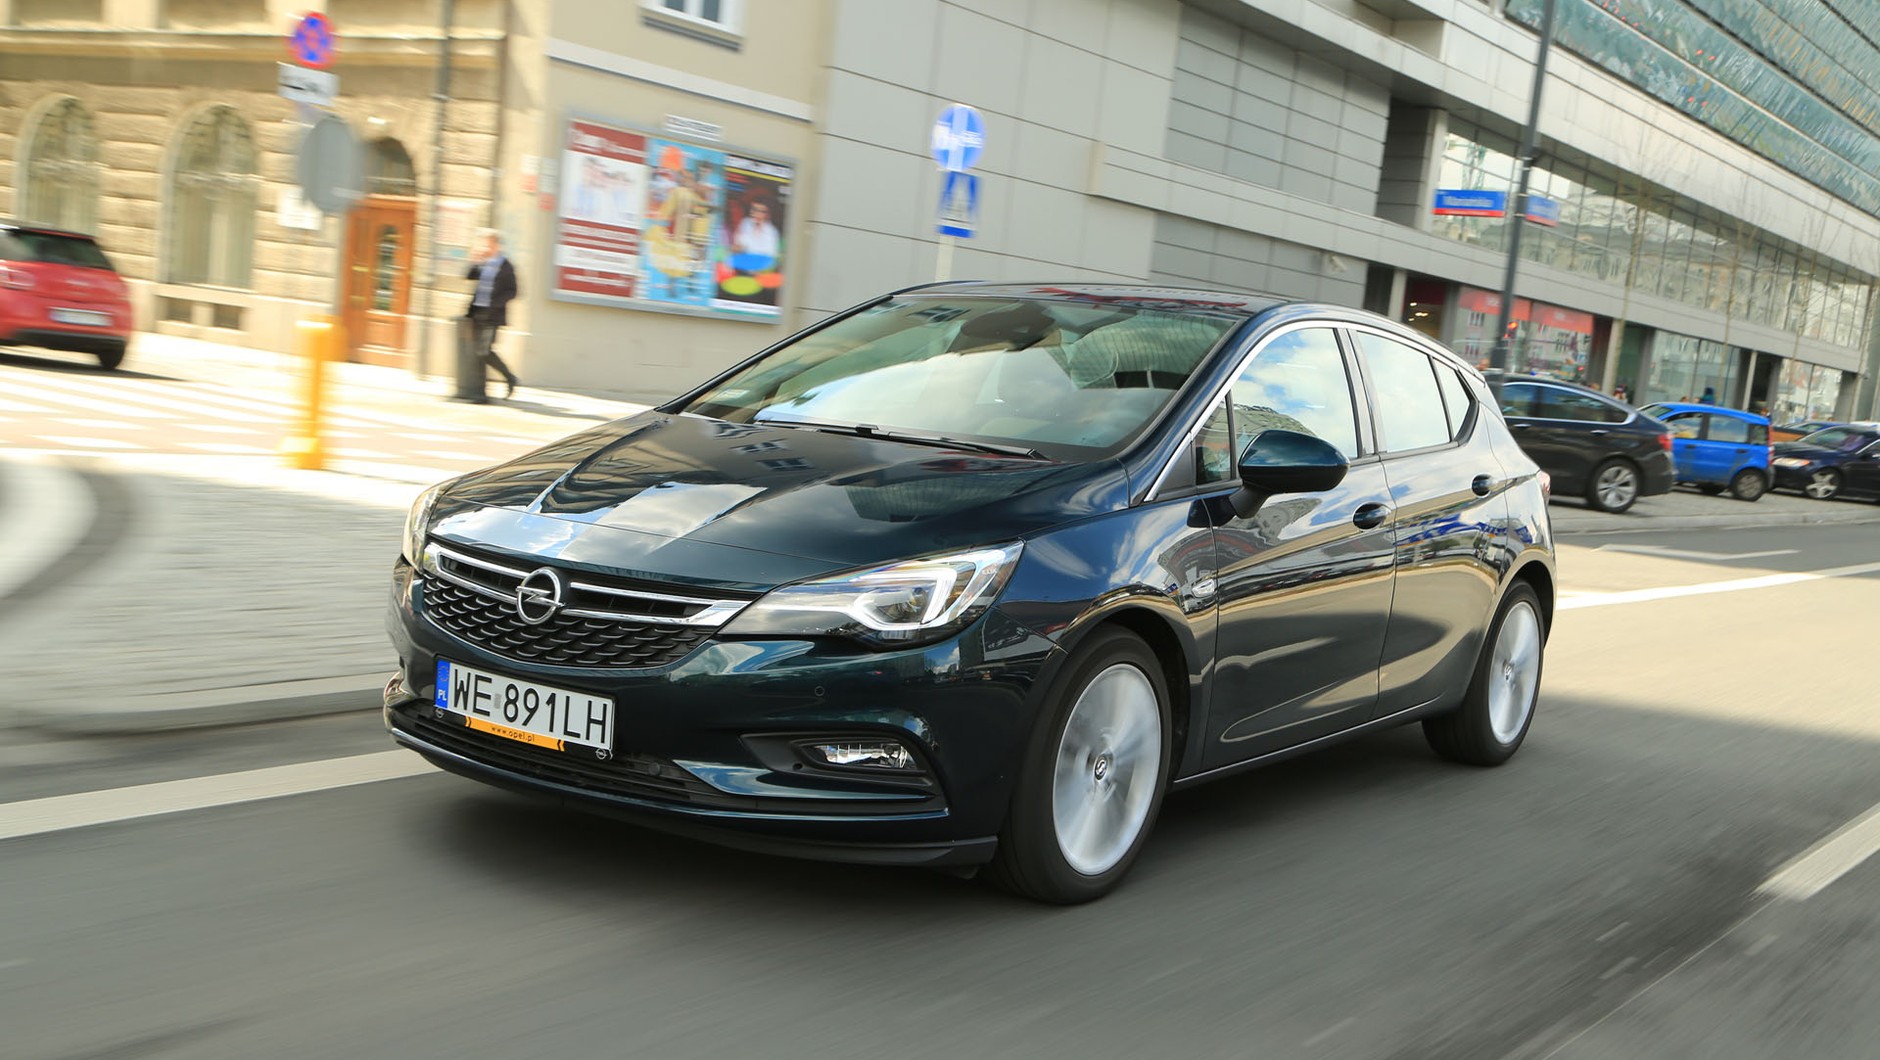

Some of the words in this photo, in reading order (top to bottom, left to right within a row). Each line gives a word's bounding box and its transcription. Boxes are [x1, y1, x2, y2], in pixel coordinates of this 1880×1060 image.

[438, 689, 447, 701] PL
[454, 668, 492, 717] WE
[503, 683, 608, 744] 891LH
[491, 727, 535, 742] www.opel.pl
